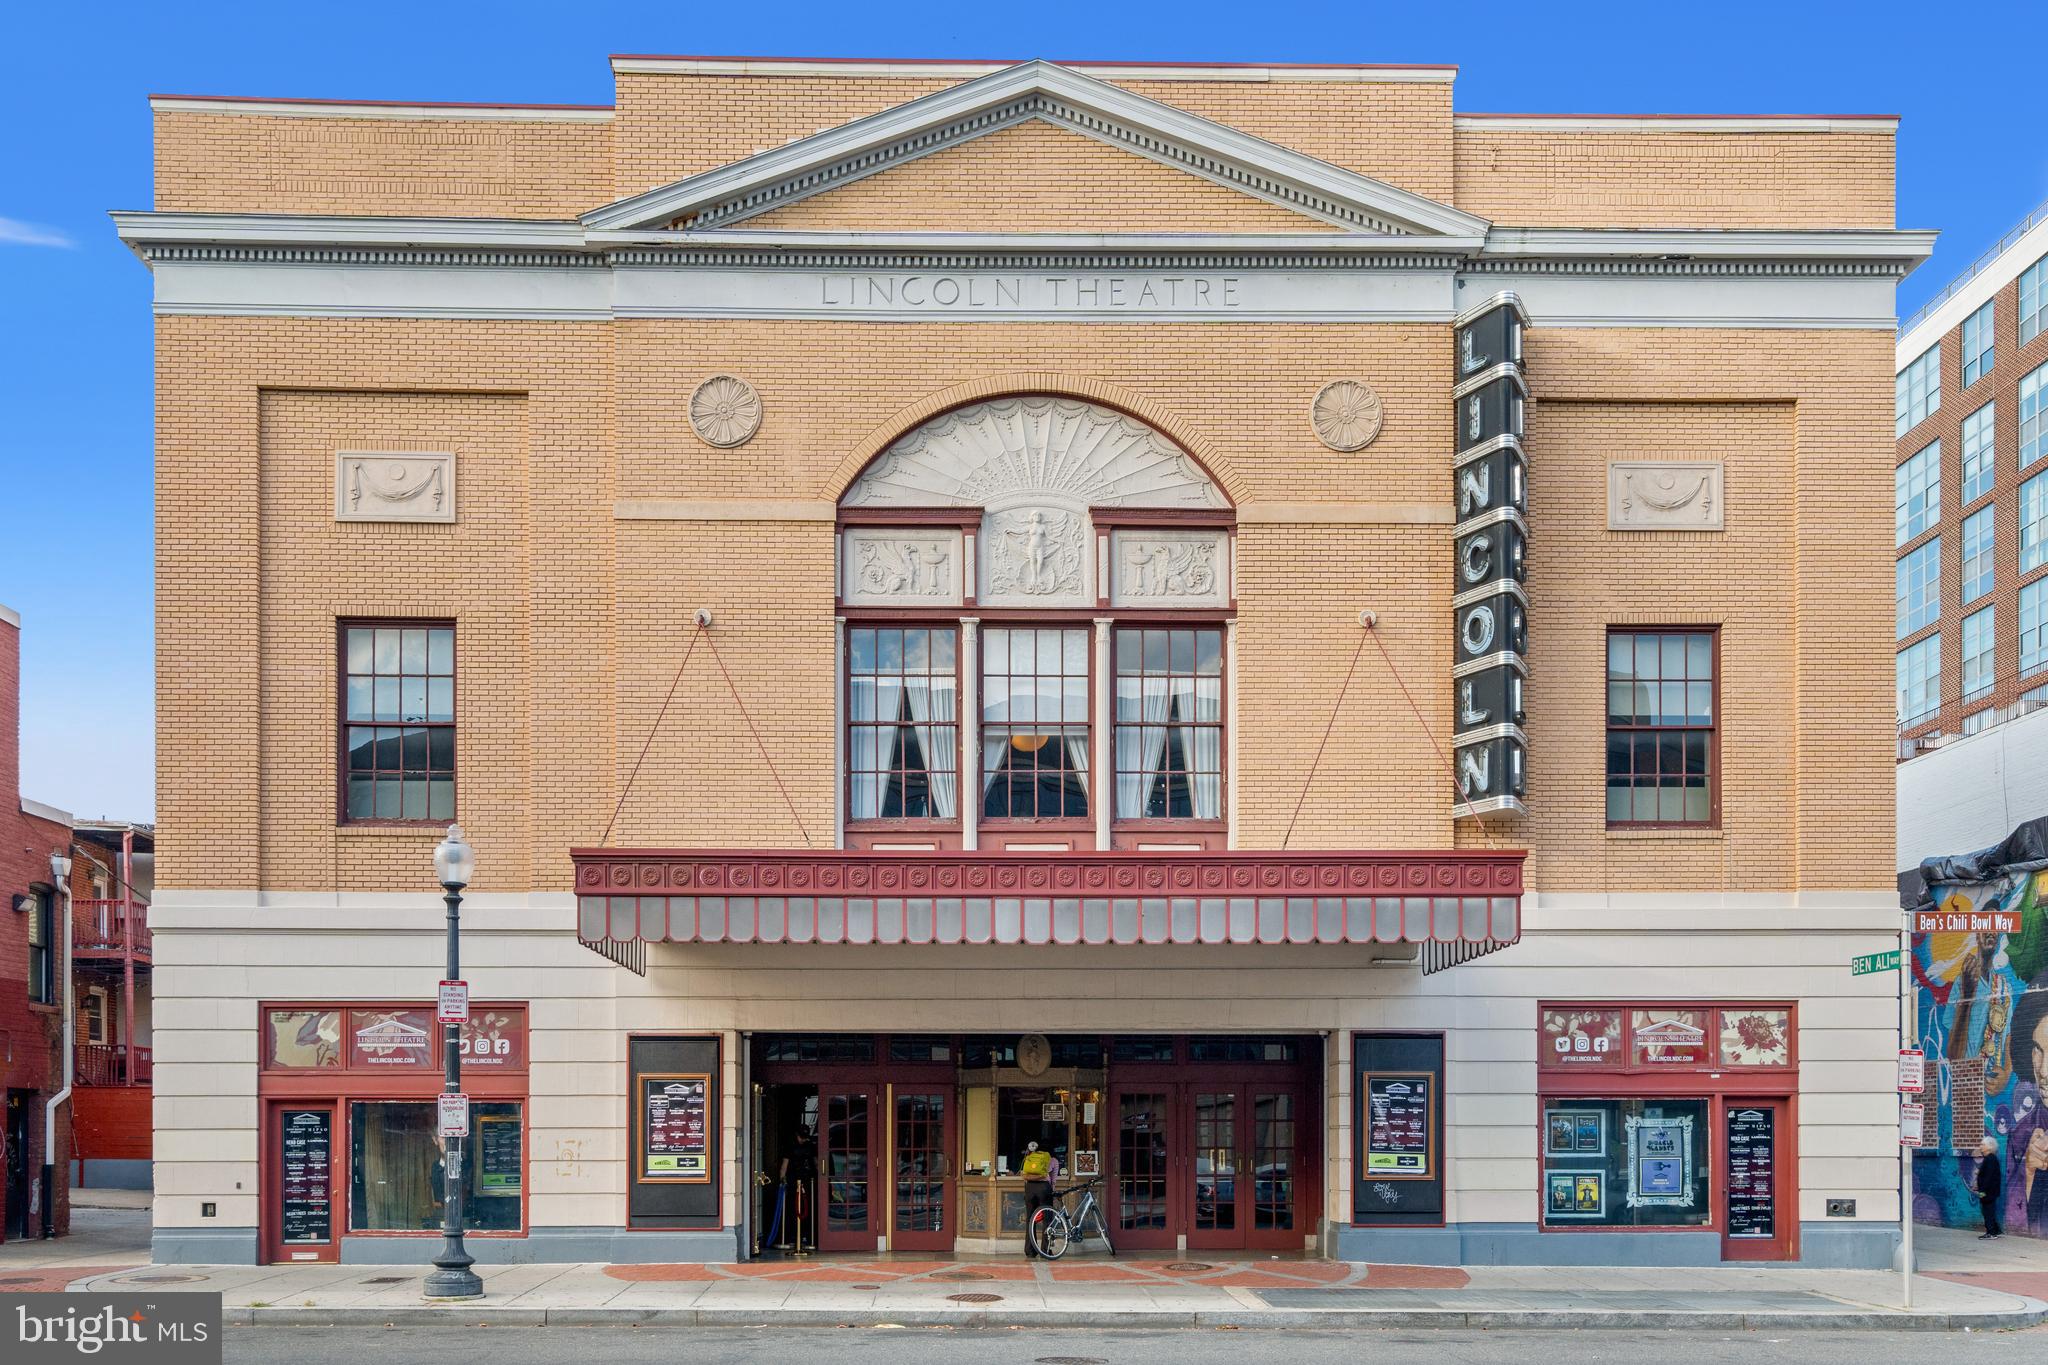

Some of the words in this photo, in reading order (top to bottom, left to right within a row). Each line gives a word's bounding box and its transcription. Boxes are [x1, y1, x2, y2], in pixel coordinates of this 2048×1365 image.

[822, 276, 1021, 306] LINCOLN
[1046, 278, 1241, 307] THEATRE
[1460, 328, 1496, 796] LINCOLN
[1920, 914, 1944, 931] Ben's
[1947, 914, 1967, 931] Chili
[1971, 915, 1991, 931] Bowl
[1995, 915, 2013, 933] Way
[1853, 956, 1872, 974] BEN
[1875, 953, 1890, 971] ALI
[461, 1057, 504, 1065] @THELINCOLNDC
[1562, 1055, 1602, 1063] @THELINCOLNDC
